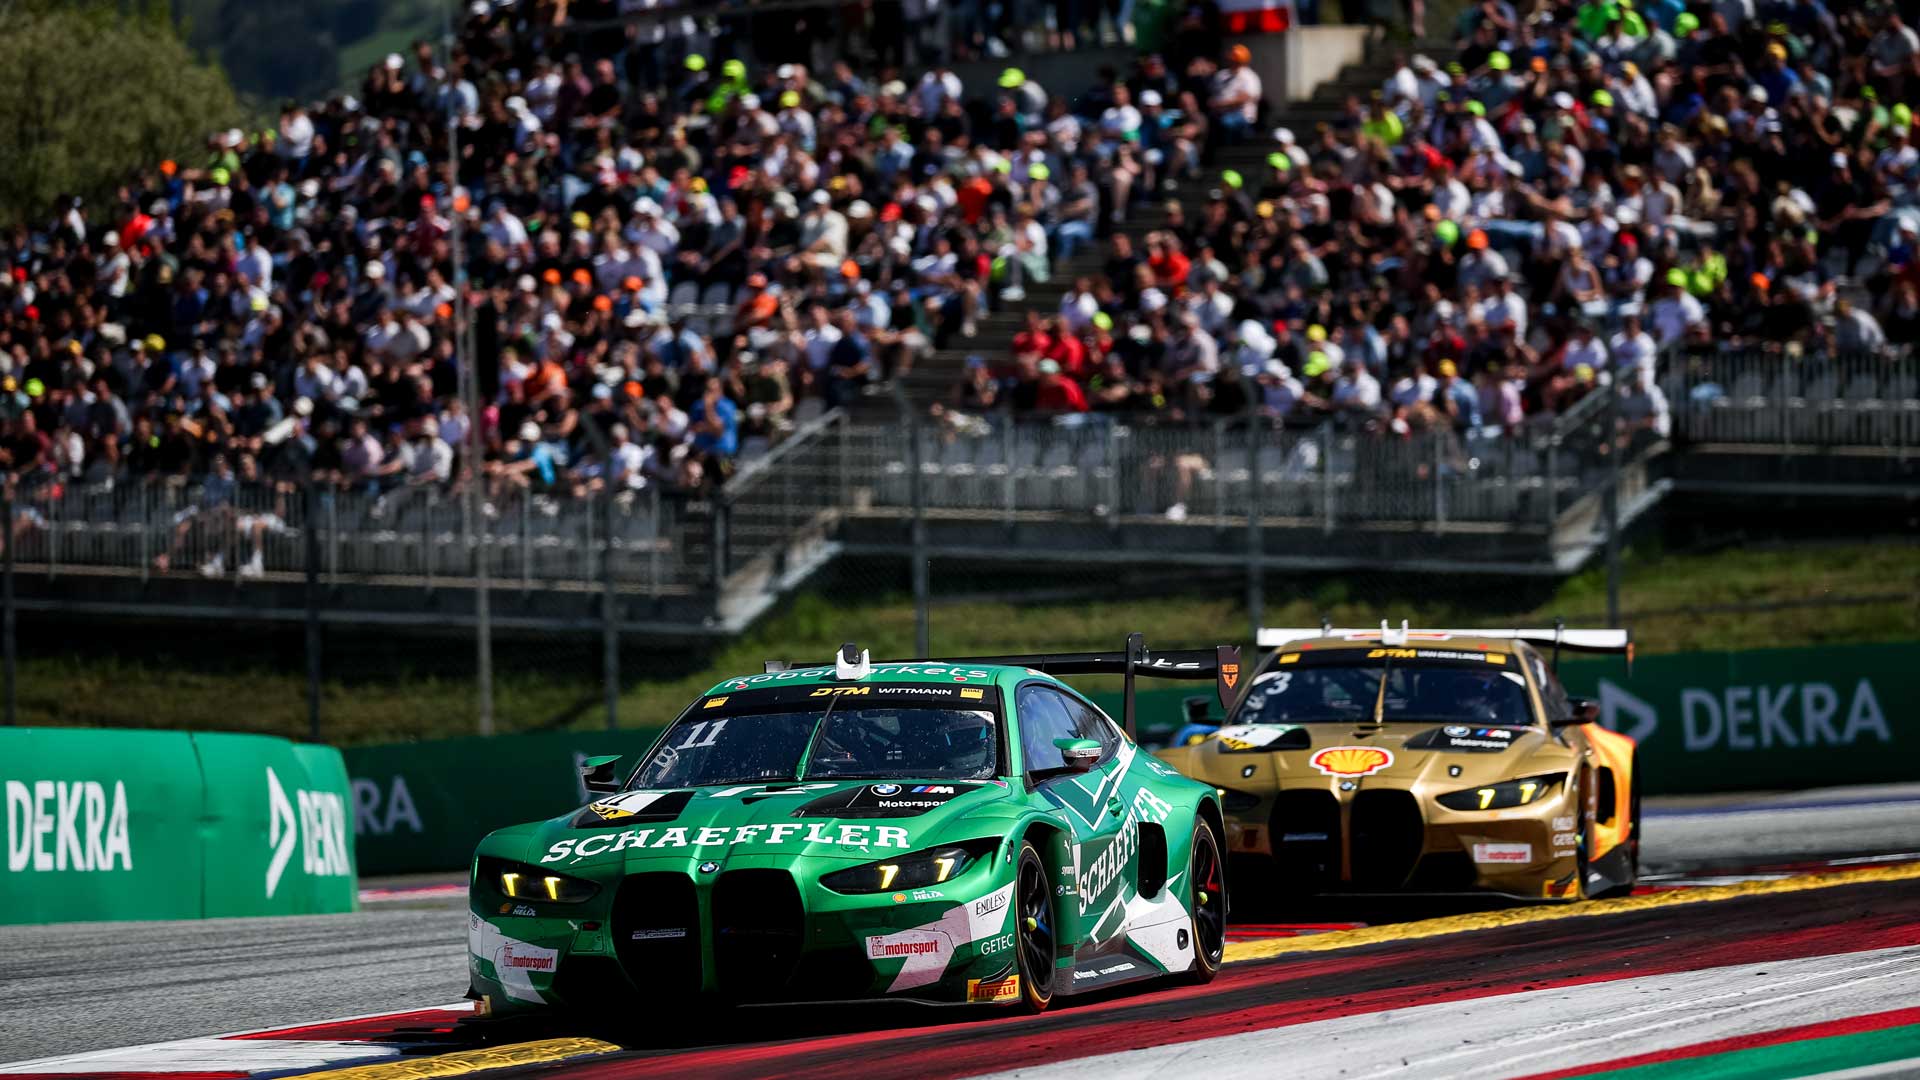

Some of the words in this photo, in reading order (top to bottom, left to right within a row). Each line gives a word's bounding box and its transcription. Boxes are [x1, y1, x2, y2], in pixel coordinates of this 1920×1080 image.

[809, 686, 871, 697] DTM
[878, 687, 952, 696] WITTMANN
[1266, 671, 1293, 695] 3
[1681, 678, 1891, 750] DEKRA
[676, 719, 729, 750] 11
[6, 780, 132, 872] DEKRA
[540, 823, 911, 864] SCHAEFFLER
[975, 891, 1006, 916] ENDLESS
[885, 939, 938, 956] motorsport
[980, 933, 1014, 955] GETEC
[512, 956, 553, 970] motorsport
[974, 979, 1016, 998] PIRELLI
